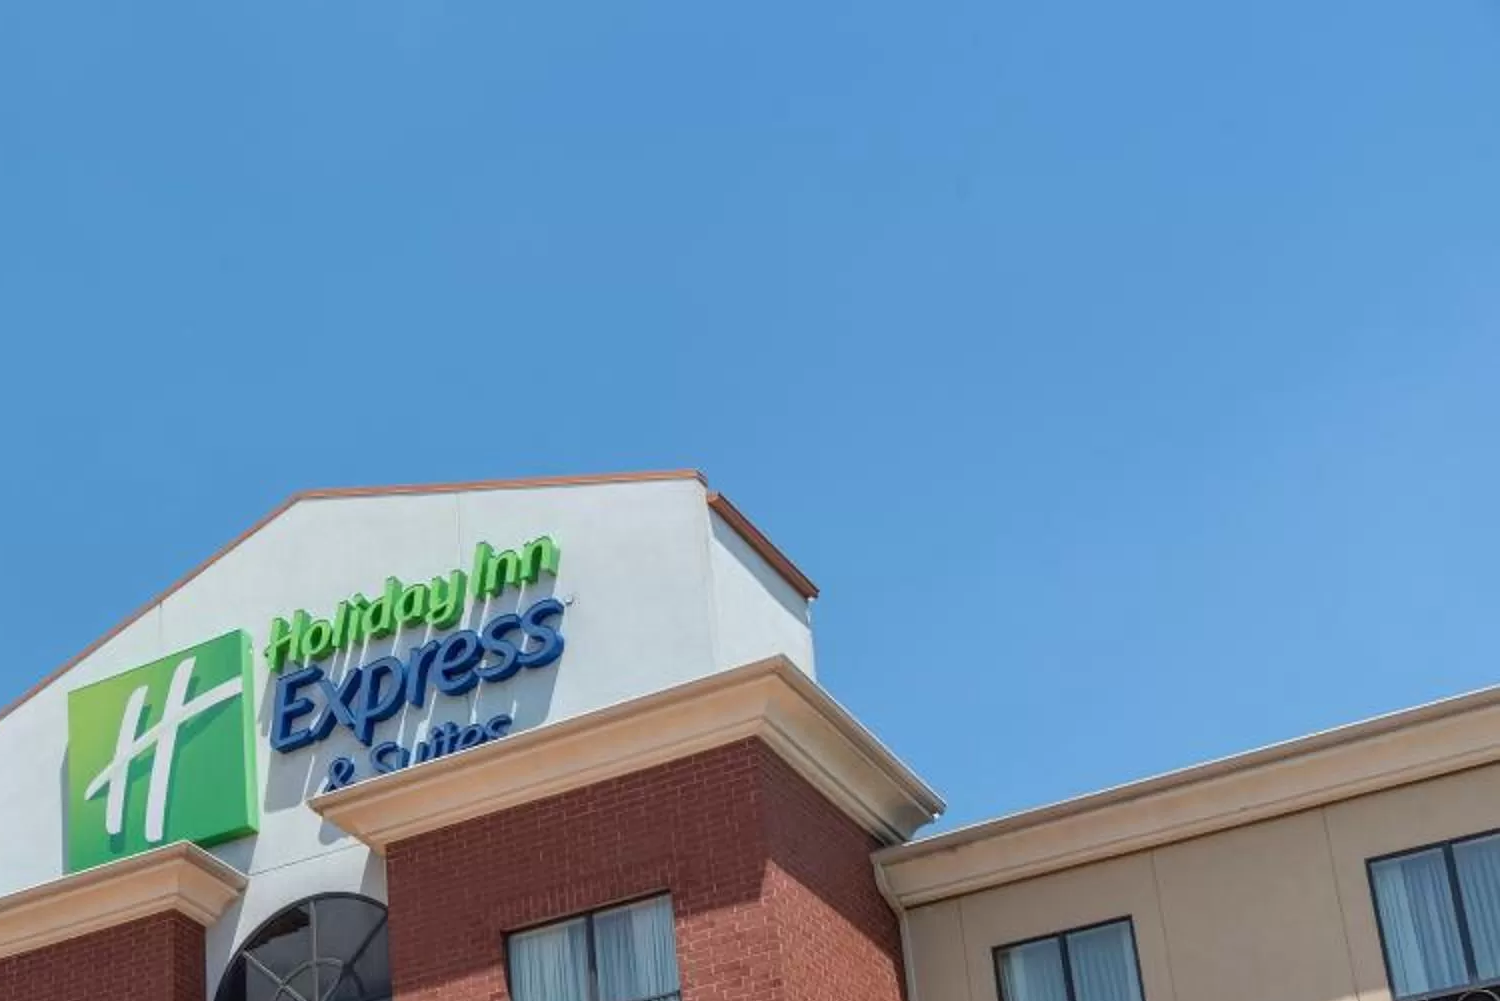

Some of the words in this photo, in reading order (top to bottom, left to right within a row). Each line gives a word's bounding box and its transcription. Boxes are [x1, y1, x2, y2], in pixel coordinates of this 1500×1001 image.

[265, 568, 467, 673] Holiday
[471, 534, 561, 601] Inn
[269, 598, 565, 754] Express
